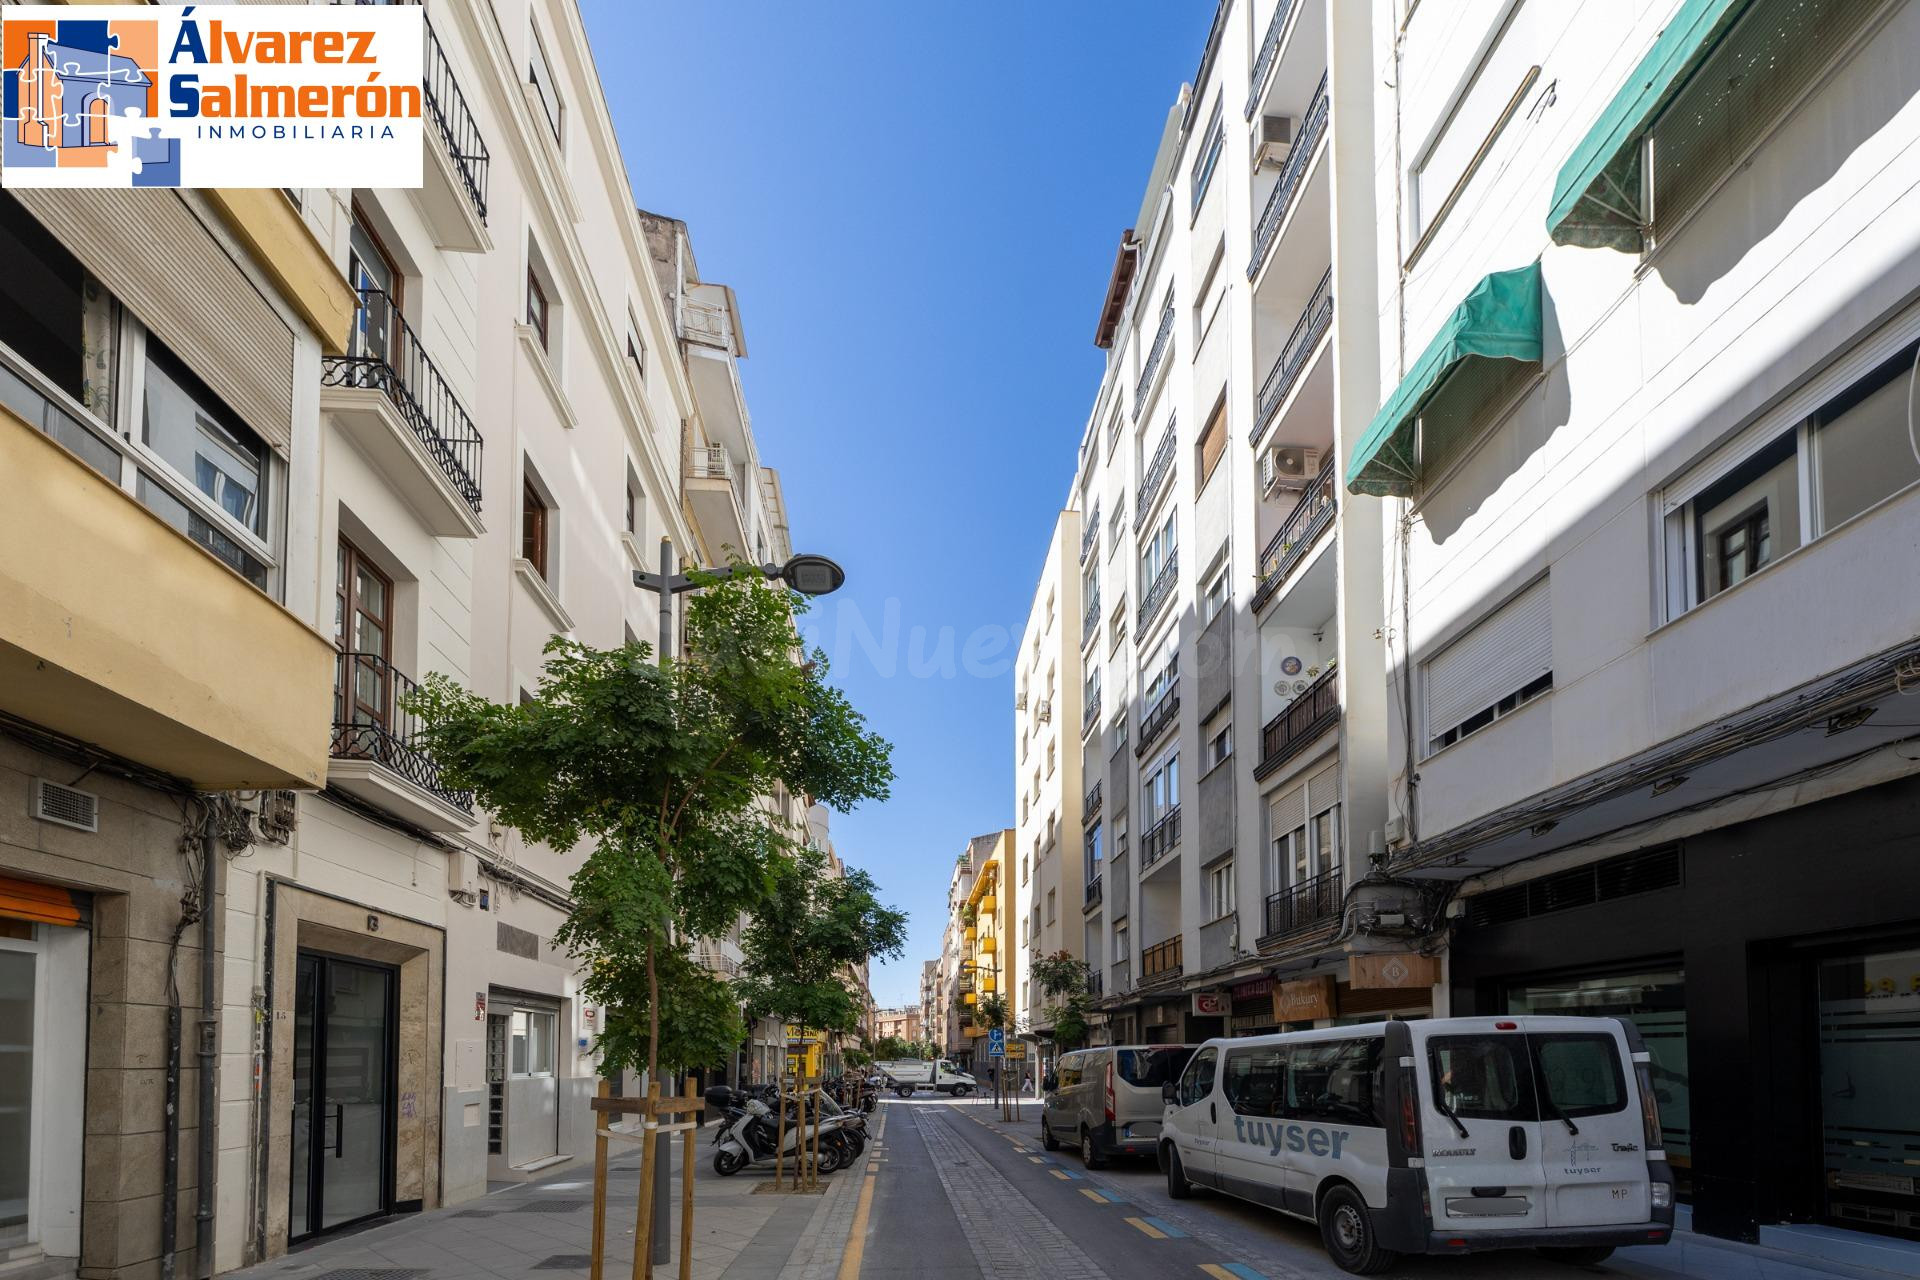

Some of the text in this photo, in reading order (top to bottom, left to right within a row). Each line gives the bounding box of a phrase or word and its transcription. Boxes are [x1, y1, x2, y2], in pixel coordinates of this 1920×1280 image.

[1233, 1115, 1350, 1160] tuyser
[1564, 1166, 1602, 1175] tuyser
[1611, 1188, 1628, 1200] MP
